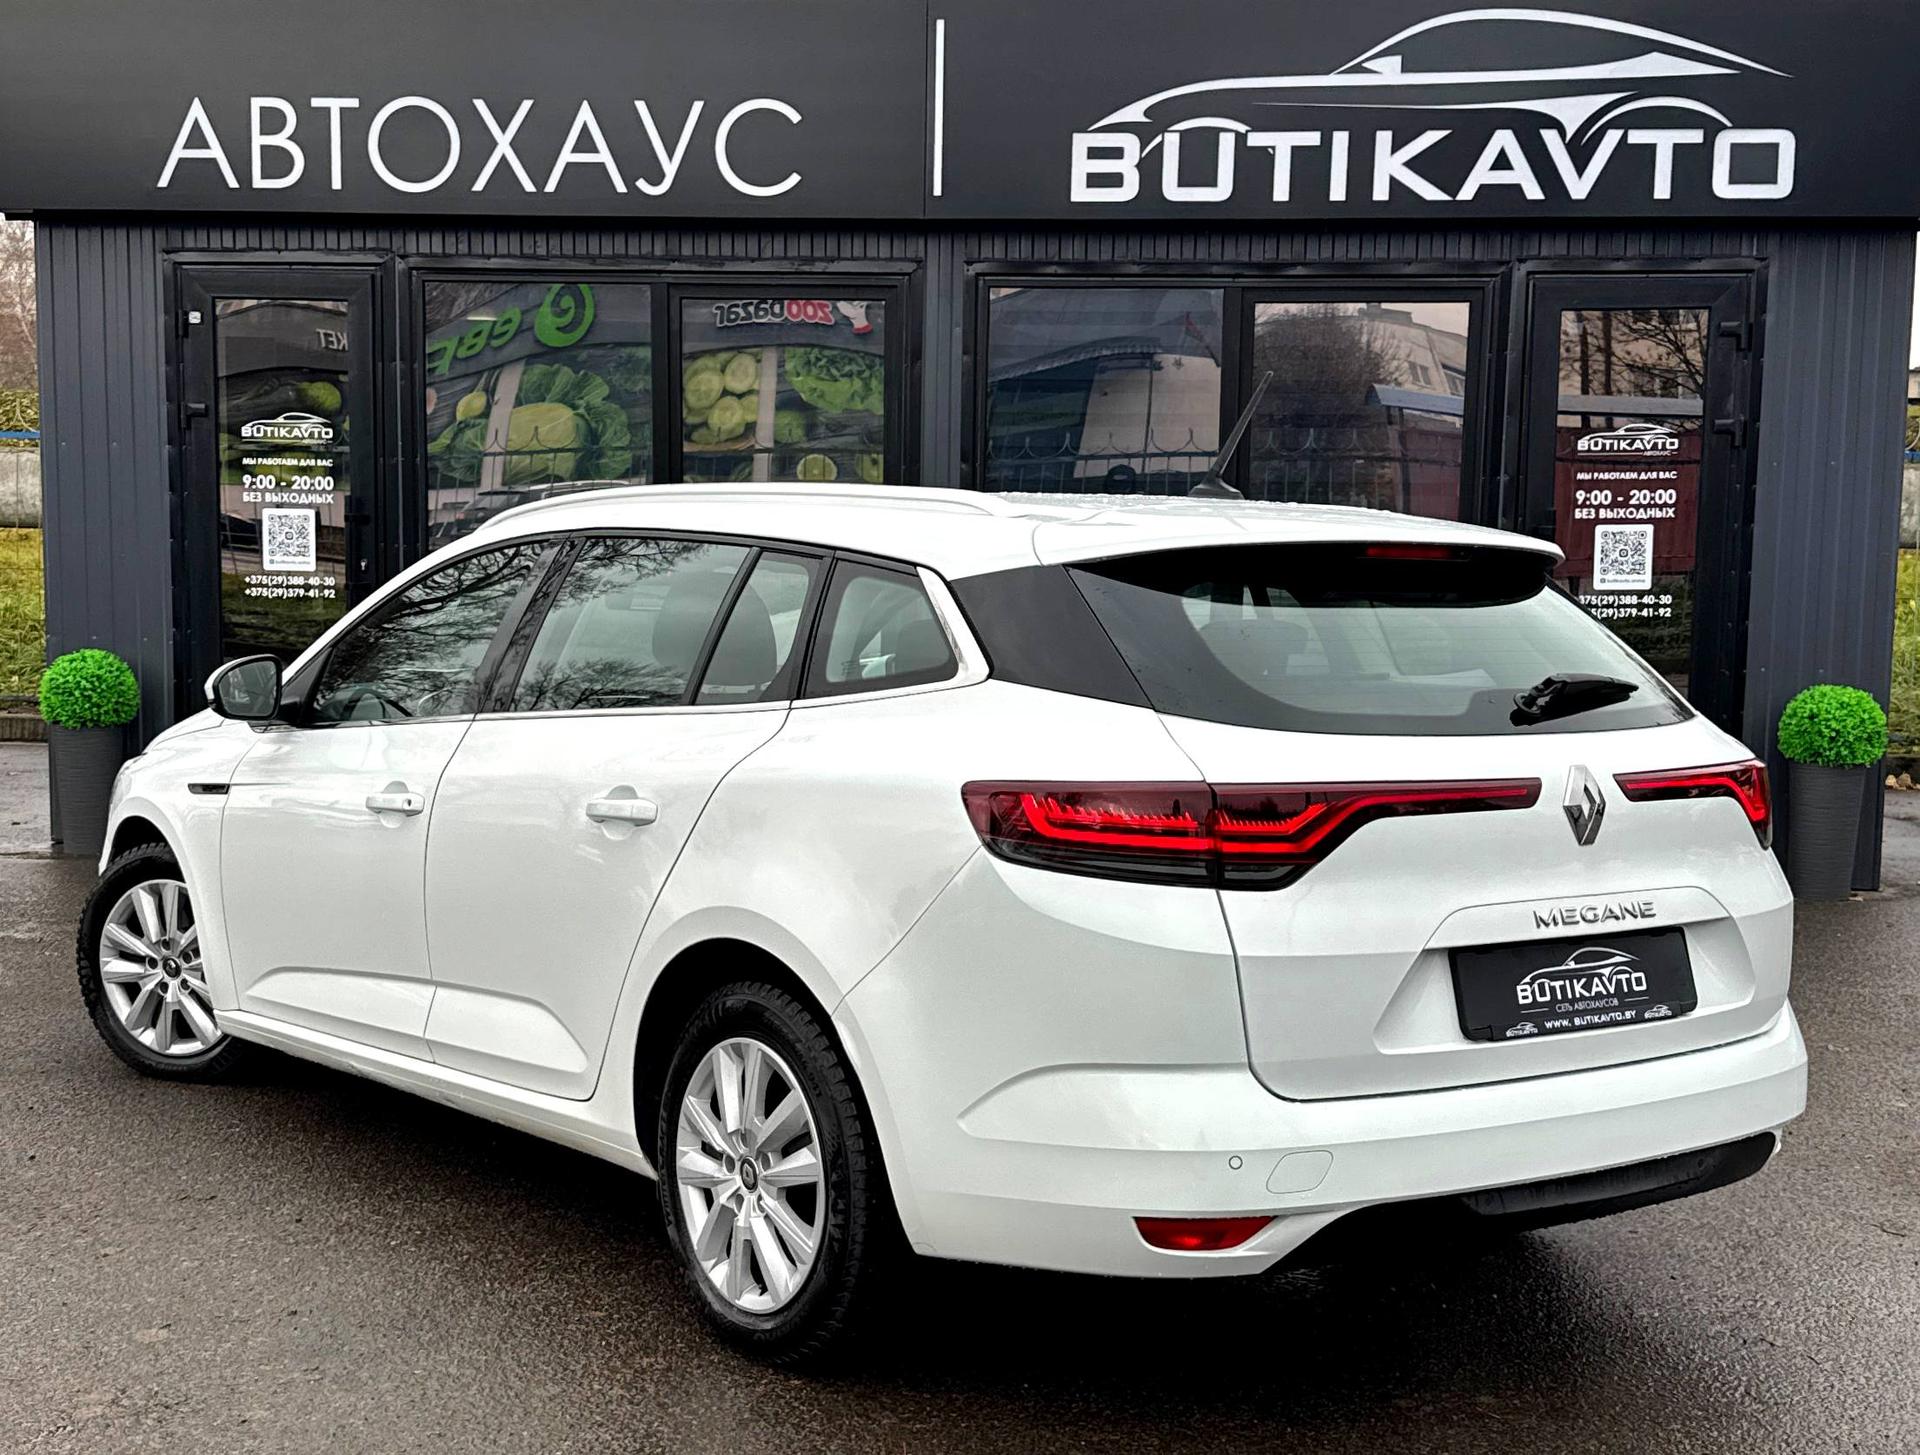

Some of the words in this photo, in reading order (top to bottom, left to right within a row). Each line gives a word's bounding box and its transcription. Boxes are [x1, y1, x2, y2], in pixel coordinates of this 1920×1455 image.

[156, 96, 803, 197] АВТОХАУС
[1071, 127, 1796, 202] BUTIKAVTO
[241, 426, 333, 439] BUTIKAVTO
[1577, 438, 1679, 451] BUTIKAVTO
[242, 457, 256, 465] МЫ
[258, 458, 298, 466] РАБОТАЕМ
[299, 459, 316, 467] ДЛЯ
[317, 459, 333, 467] ВАС
[1577, 472, 1592, 480] МЫ
[1593, 472, 1638, 480] РАБОТАЕМ
[1639, 471, 1658, 480] ДЛЯ
[1659, 471, 1678, 479] ВАС
[242, 474, 276, 489] 9:00
[291, 475, 334, 491] 20:00
[242, 492, 262, 502] БЕЗ
[264, 492, 334, 504] ВЫХОДНЫХ
[1575, 489, 1612, 505] 9:00
[1629, 489, 1677, 505] 20:00
[1574, 508, 1596, 519] БЕЗ
[1599, 507, 1676, 519] ВЫХОДНЫХ
[244, 575, 335, 587] +375(29)388-40-30
[244, 588, 335, 599] +375(29)379-41-92
[1579, 594, 1672, 607] 375(29)388-40-30
[1590, 607, 1672, 620] 5(29)379-41-92
[1533, 901, 1657, 929] MEGANE
[1516, 971, 1647, 1004] BUTIKAVTO
[1556, 1004, 1573, 1013] СЕТЬ
[1574, 998, 1619, 1011] АВТОХАУСОВ
[1545, 1018, 1572, 1029] WWW.
[1574, 1010, 1637, 1026] BUTIKAVTO.BY
